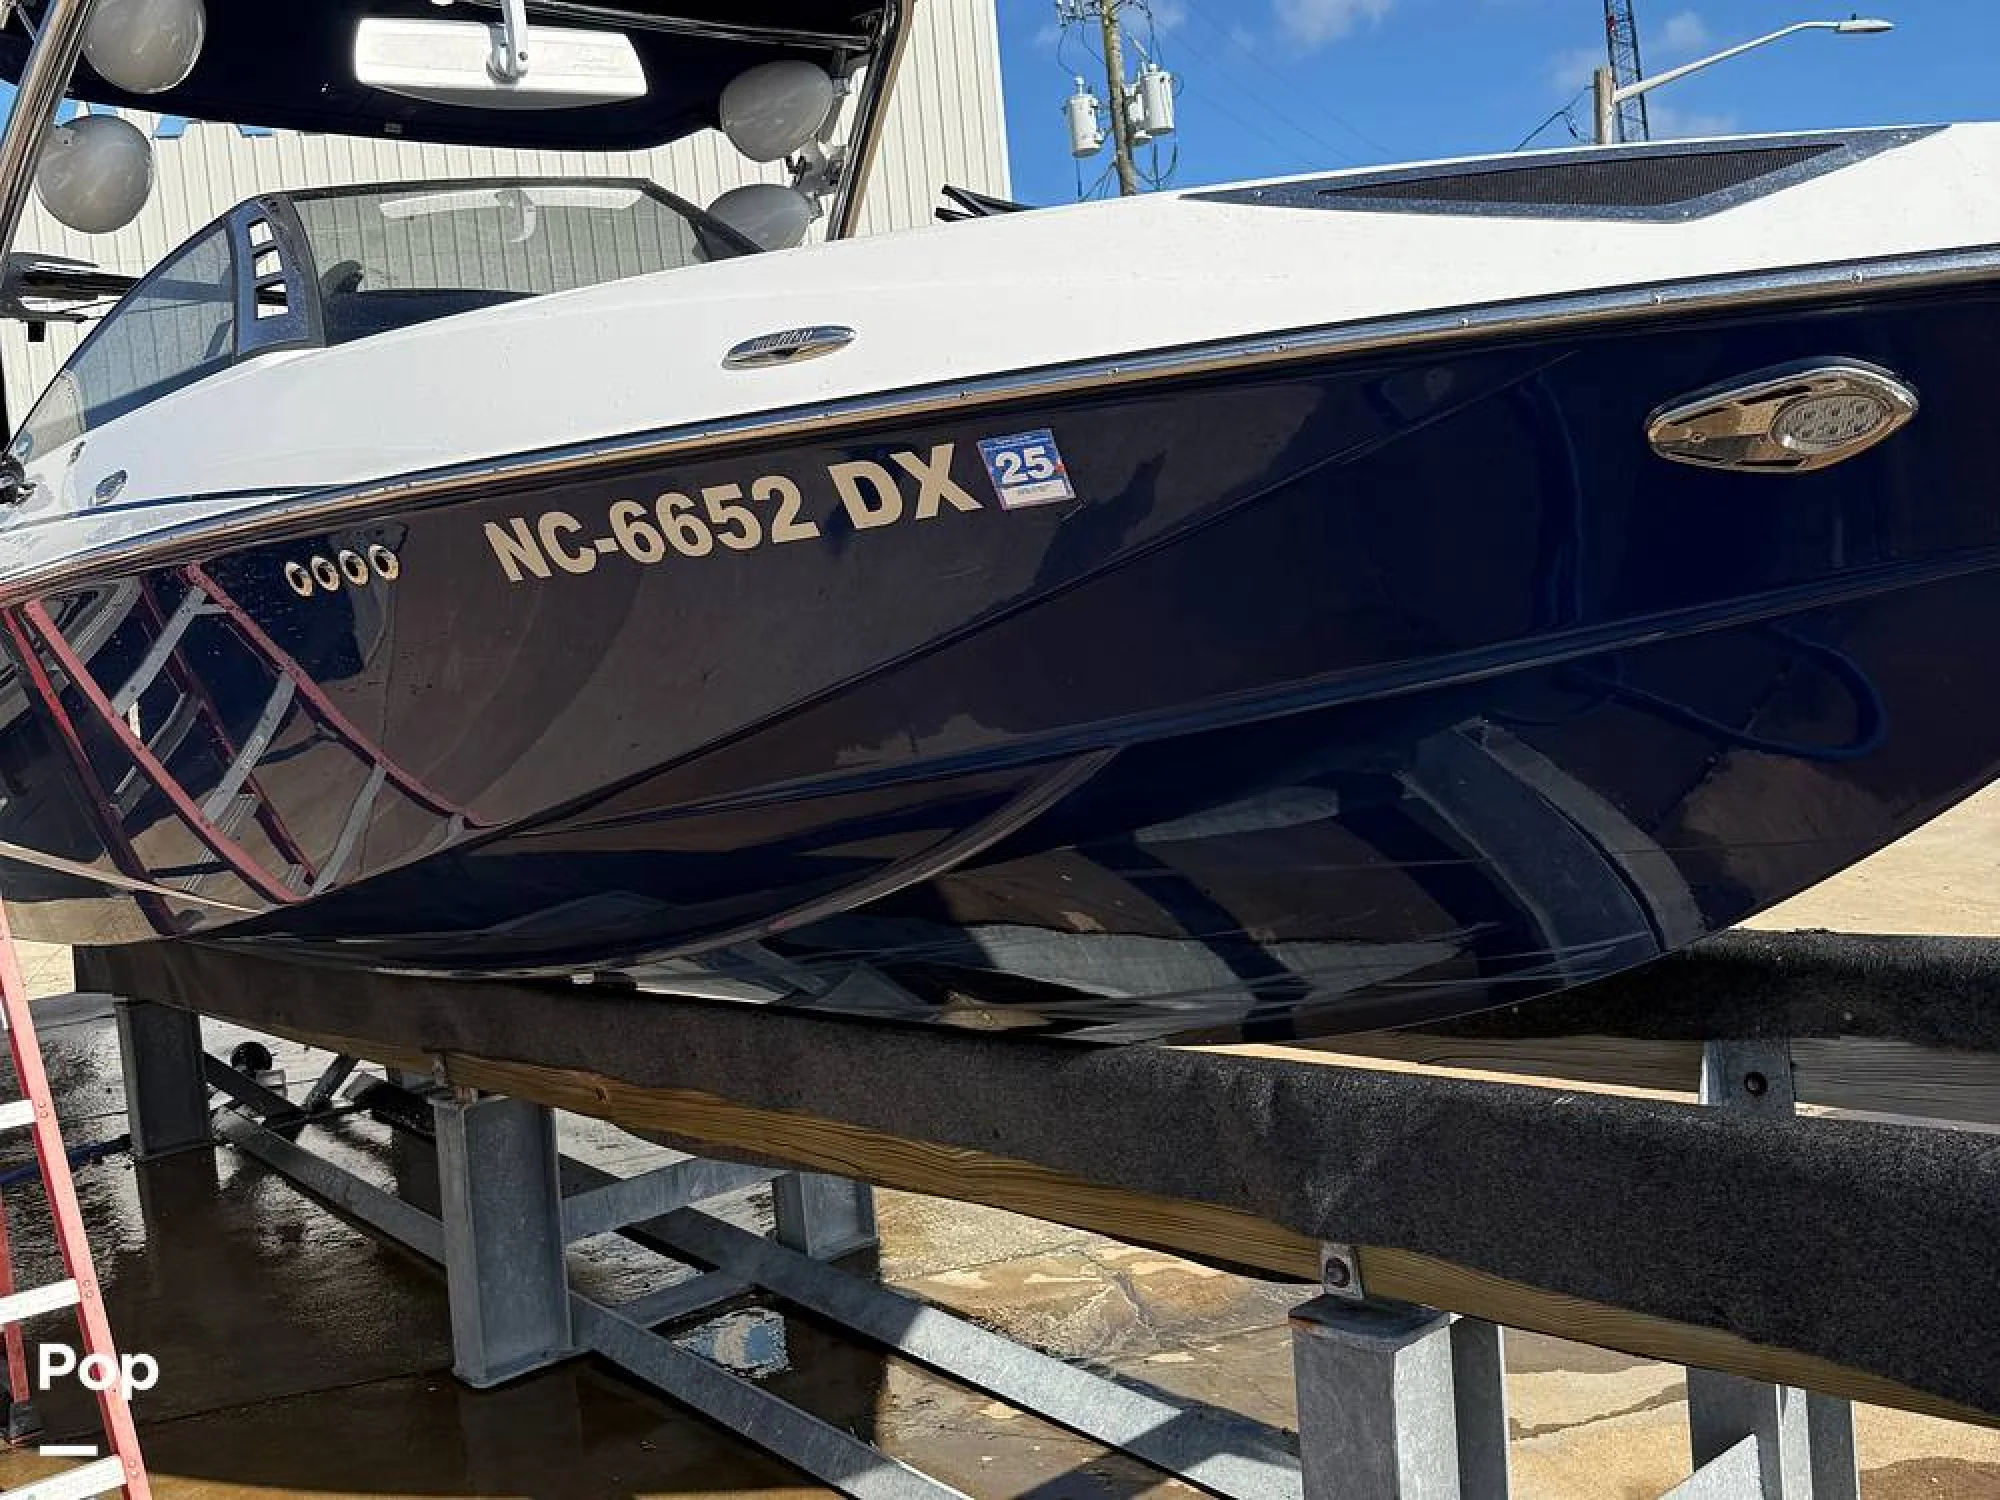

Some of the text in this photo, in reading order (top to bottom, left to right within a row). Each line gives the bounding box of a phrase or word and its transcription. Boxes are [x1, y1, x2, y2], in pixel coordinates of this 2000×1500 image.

[995, 445, 1055, 484] 25
[484, 444, 982, 582] NC-6652 DX
